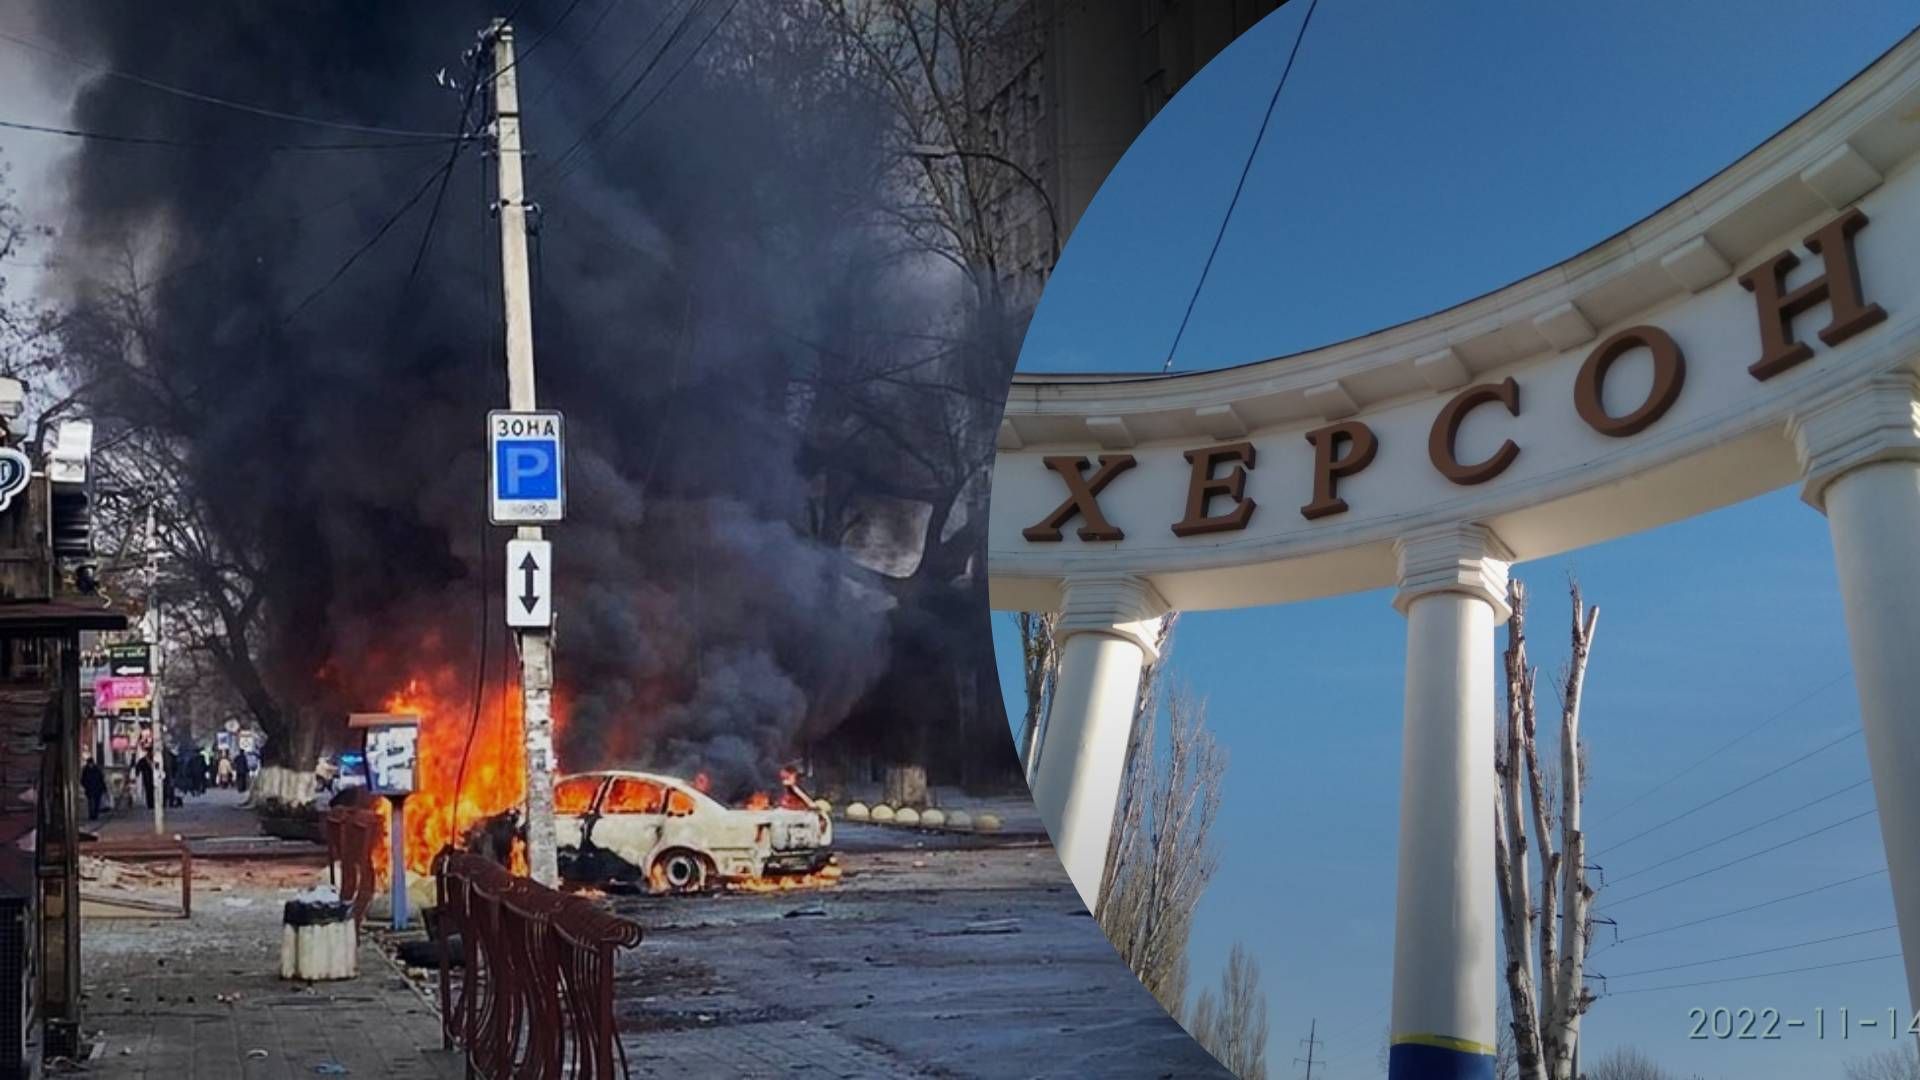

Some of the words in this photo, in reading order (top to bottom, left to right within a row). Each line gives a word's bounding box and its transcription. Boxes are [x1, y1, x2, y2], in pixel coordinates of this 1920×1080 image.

[1022, 208, 1888, 542] ХЕРСОН
[498, 419, 555, 437] ЗОНА
[506, 448, 549, 495] P
